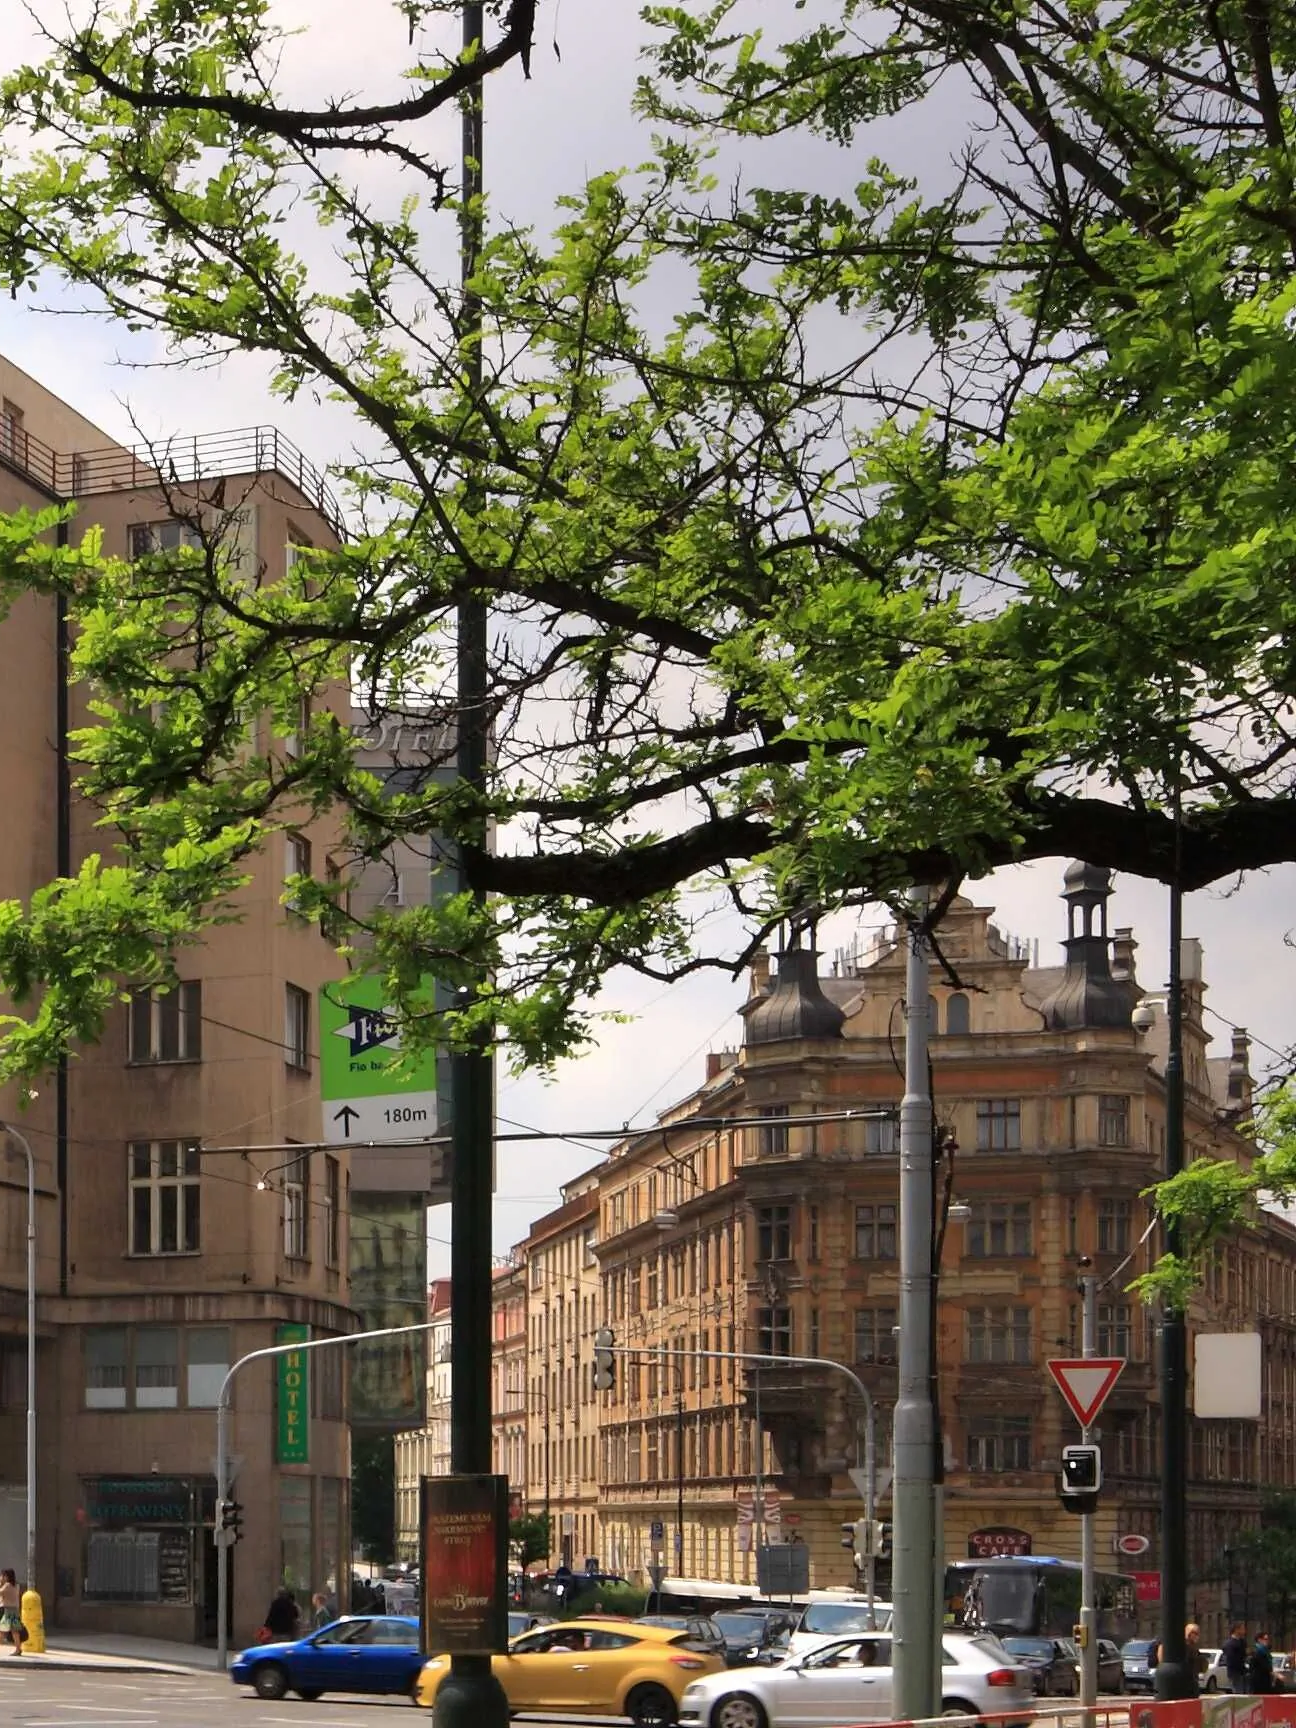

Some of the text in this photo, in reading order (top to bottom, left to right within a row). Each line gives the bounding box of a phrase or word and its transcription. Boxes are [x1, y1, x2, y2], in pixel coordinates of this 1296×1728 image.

[384, 1107, 427, 1123] 180m
[286, 1352, 301, 1445] HOTEL
[973, 1535, 1029, 1545] CROSS
